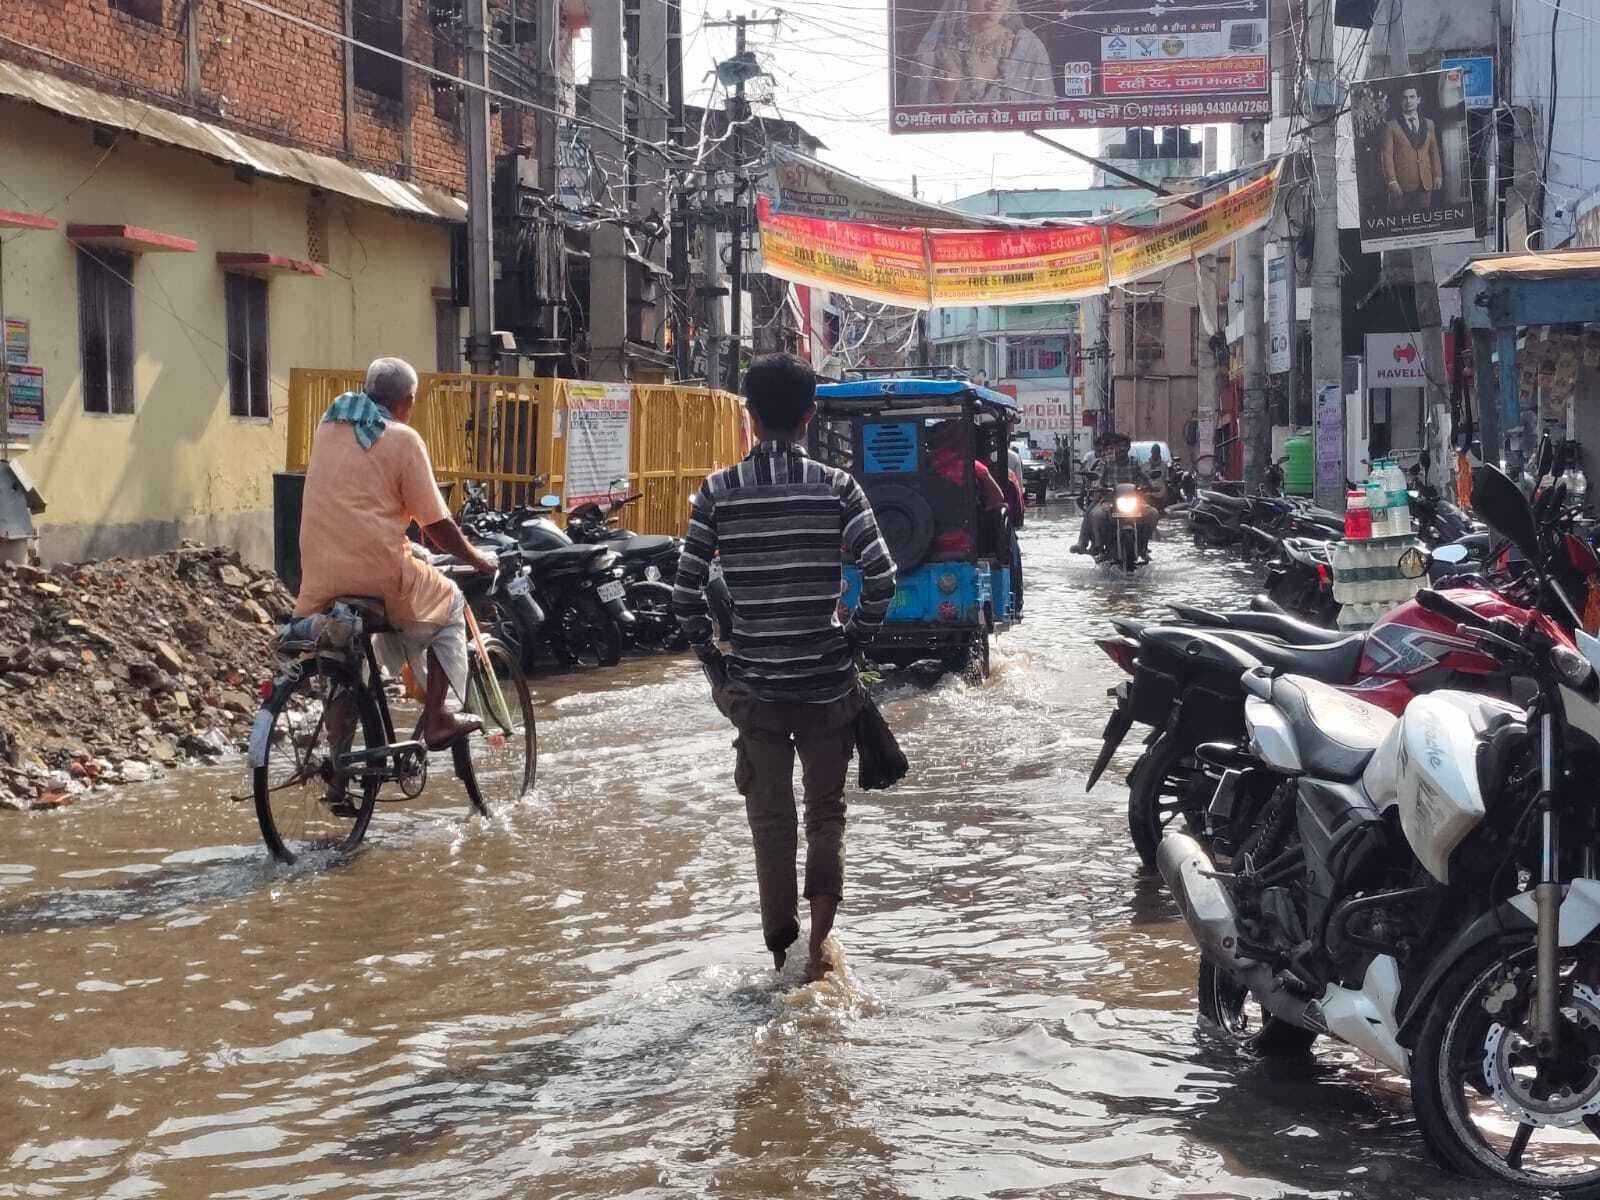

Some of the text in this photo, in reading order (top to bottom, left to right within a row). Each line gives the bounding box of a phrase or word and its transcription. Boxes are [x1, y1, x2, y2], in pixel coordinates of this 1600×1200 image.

[1367, 216, 1396, 229] VAN
[1401, 208, 1464, 224] HEUSEN
[1145, 238, 1166, 257] FREE
[1377, 368, 1424, 378] HAVELL
[1023, 404, 1082, 416] MOBILE
[1025, 418, 1082, 430] HOUSE
